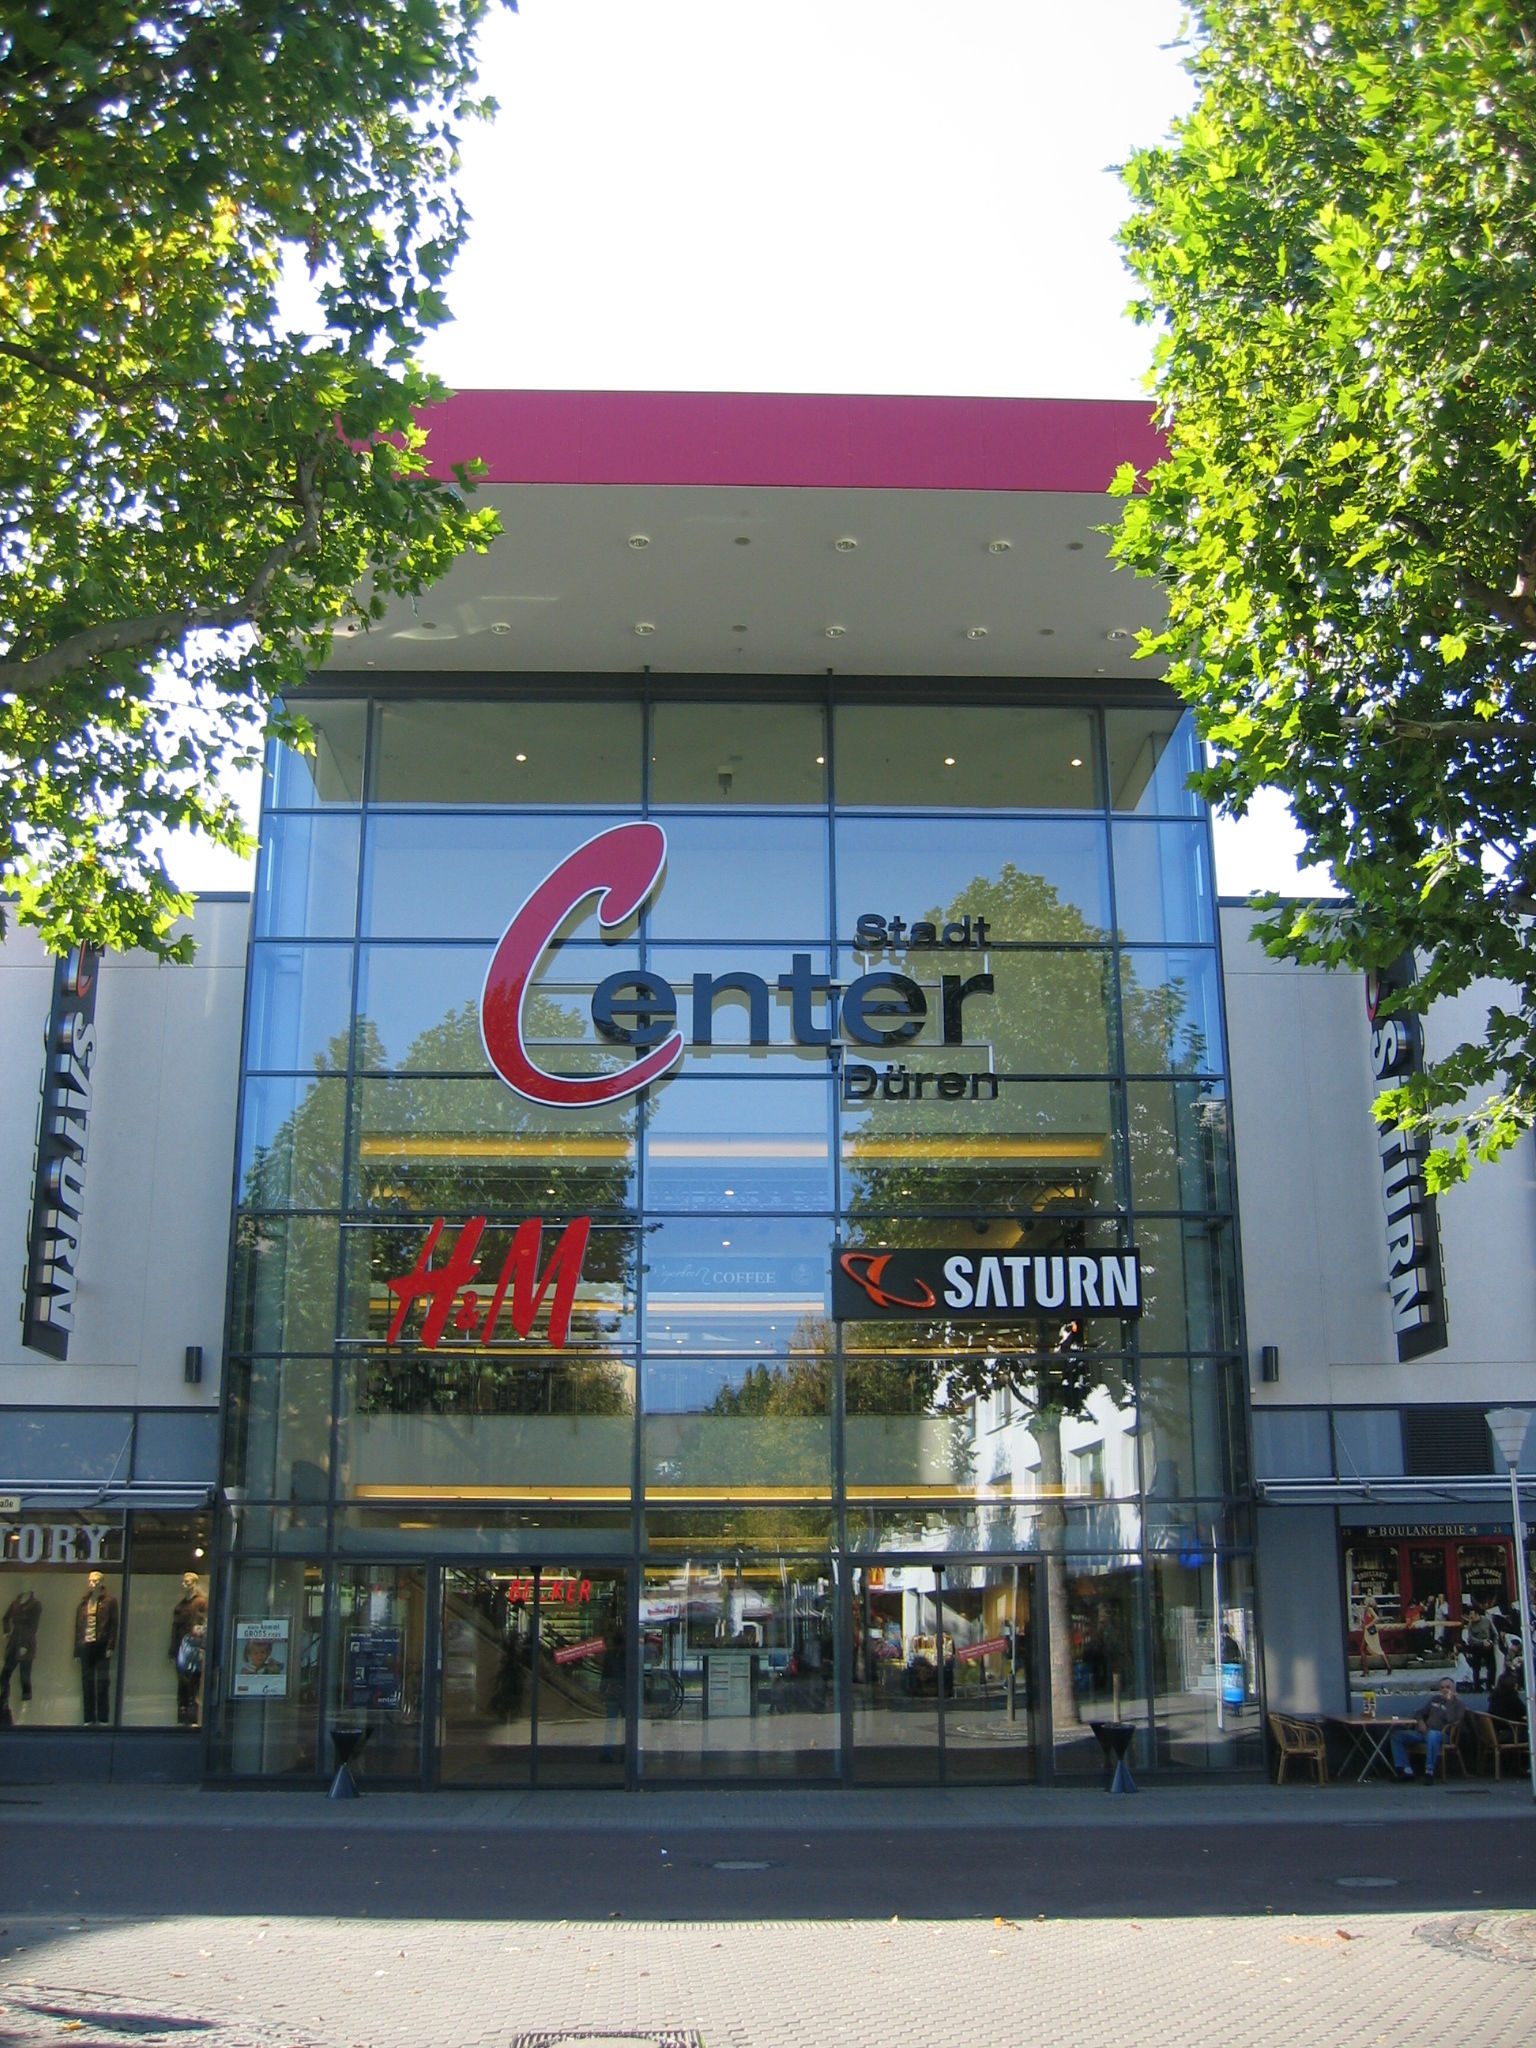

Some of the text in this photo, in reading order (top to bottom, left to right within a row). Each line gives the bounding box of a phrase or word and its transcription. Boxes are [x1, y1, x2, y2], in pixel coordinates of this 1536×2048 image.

[854, 913, 991, 950] Stadt
[480, 821, 995, 1108] Center
[844, 1063, 999, 1101] Düren
[44, 1011, 97, 1332] SATURN
[387, 1215, 592, 1349] H&M
[713, 1271, 776, 1284] COFFEE
[943, 1255, 1138, 1309] SATURN
[1379, 1525, 1466, 1537] BOULANGERIE
